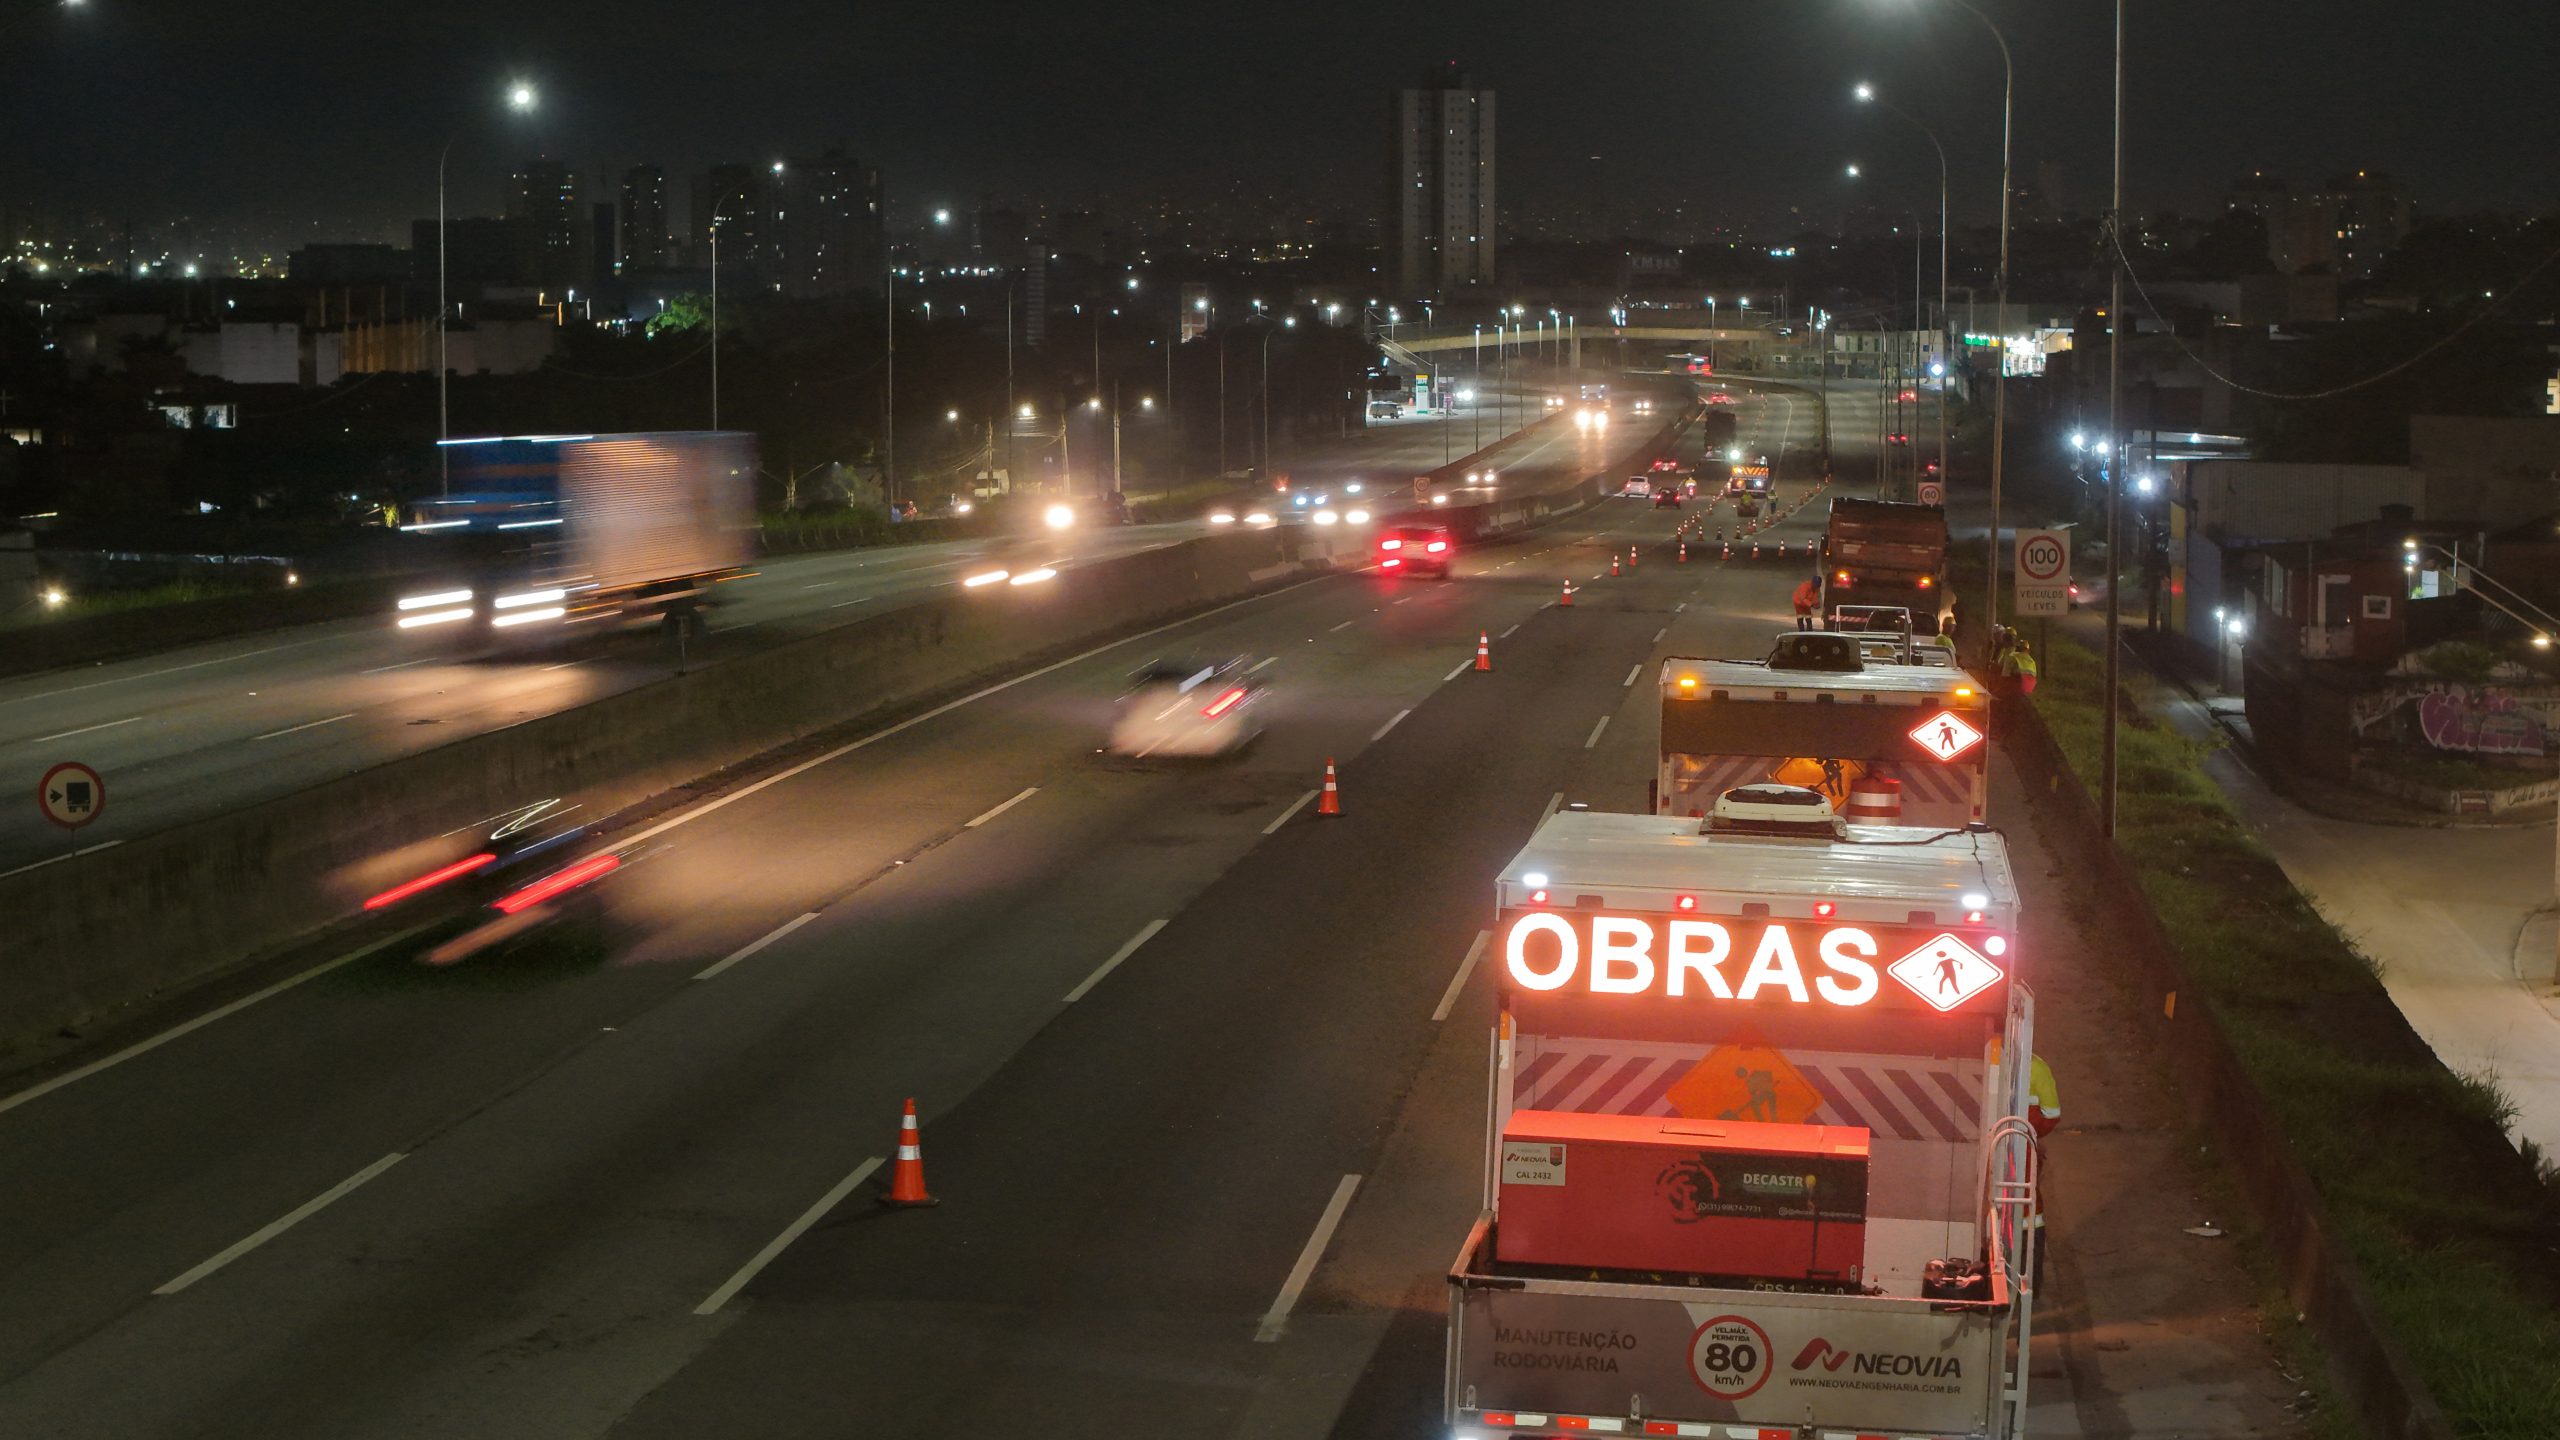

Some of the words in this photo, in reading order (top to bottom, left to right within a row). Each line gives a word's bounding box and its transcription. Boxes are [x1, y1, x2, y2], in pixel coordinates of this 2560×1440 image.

[1924, 490, 1937, 499] 80
[2029, 548, 2058, 564] 100
[2027, 602, 2057, 610] LEVES
[1506, 912, 1879, 1006] OBRAS
[1516, 1171, 1531, 1179] CAL
[1533, 1172, 1552, 1180] 2432
[1742, 1173, 1816, 1188] DECASTR
[1495, 1327, 1636, 1351] MANUTENÇÃO
[1711, 1334, 1750, 1342] PERMITIDA
[1494, 1351, 1620, 1374] RODOVIÁRIA
[1704, 1343, 1757, 1374] 80
[1853, 1353, 1962, 1379] NEOVIA
[1714, 1374, 1744, 1386] km/h
[1789, 1377, 1961, 1395] WWW.NEOVIAENGENHARIA.COM.BR
